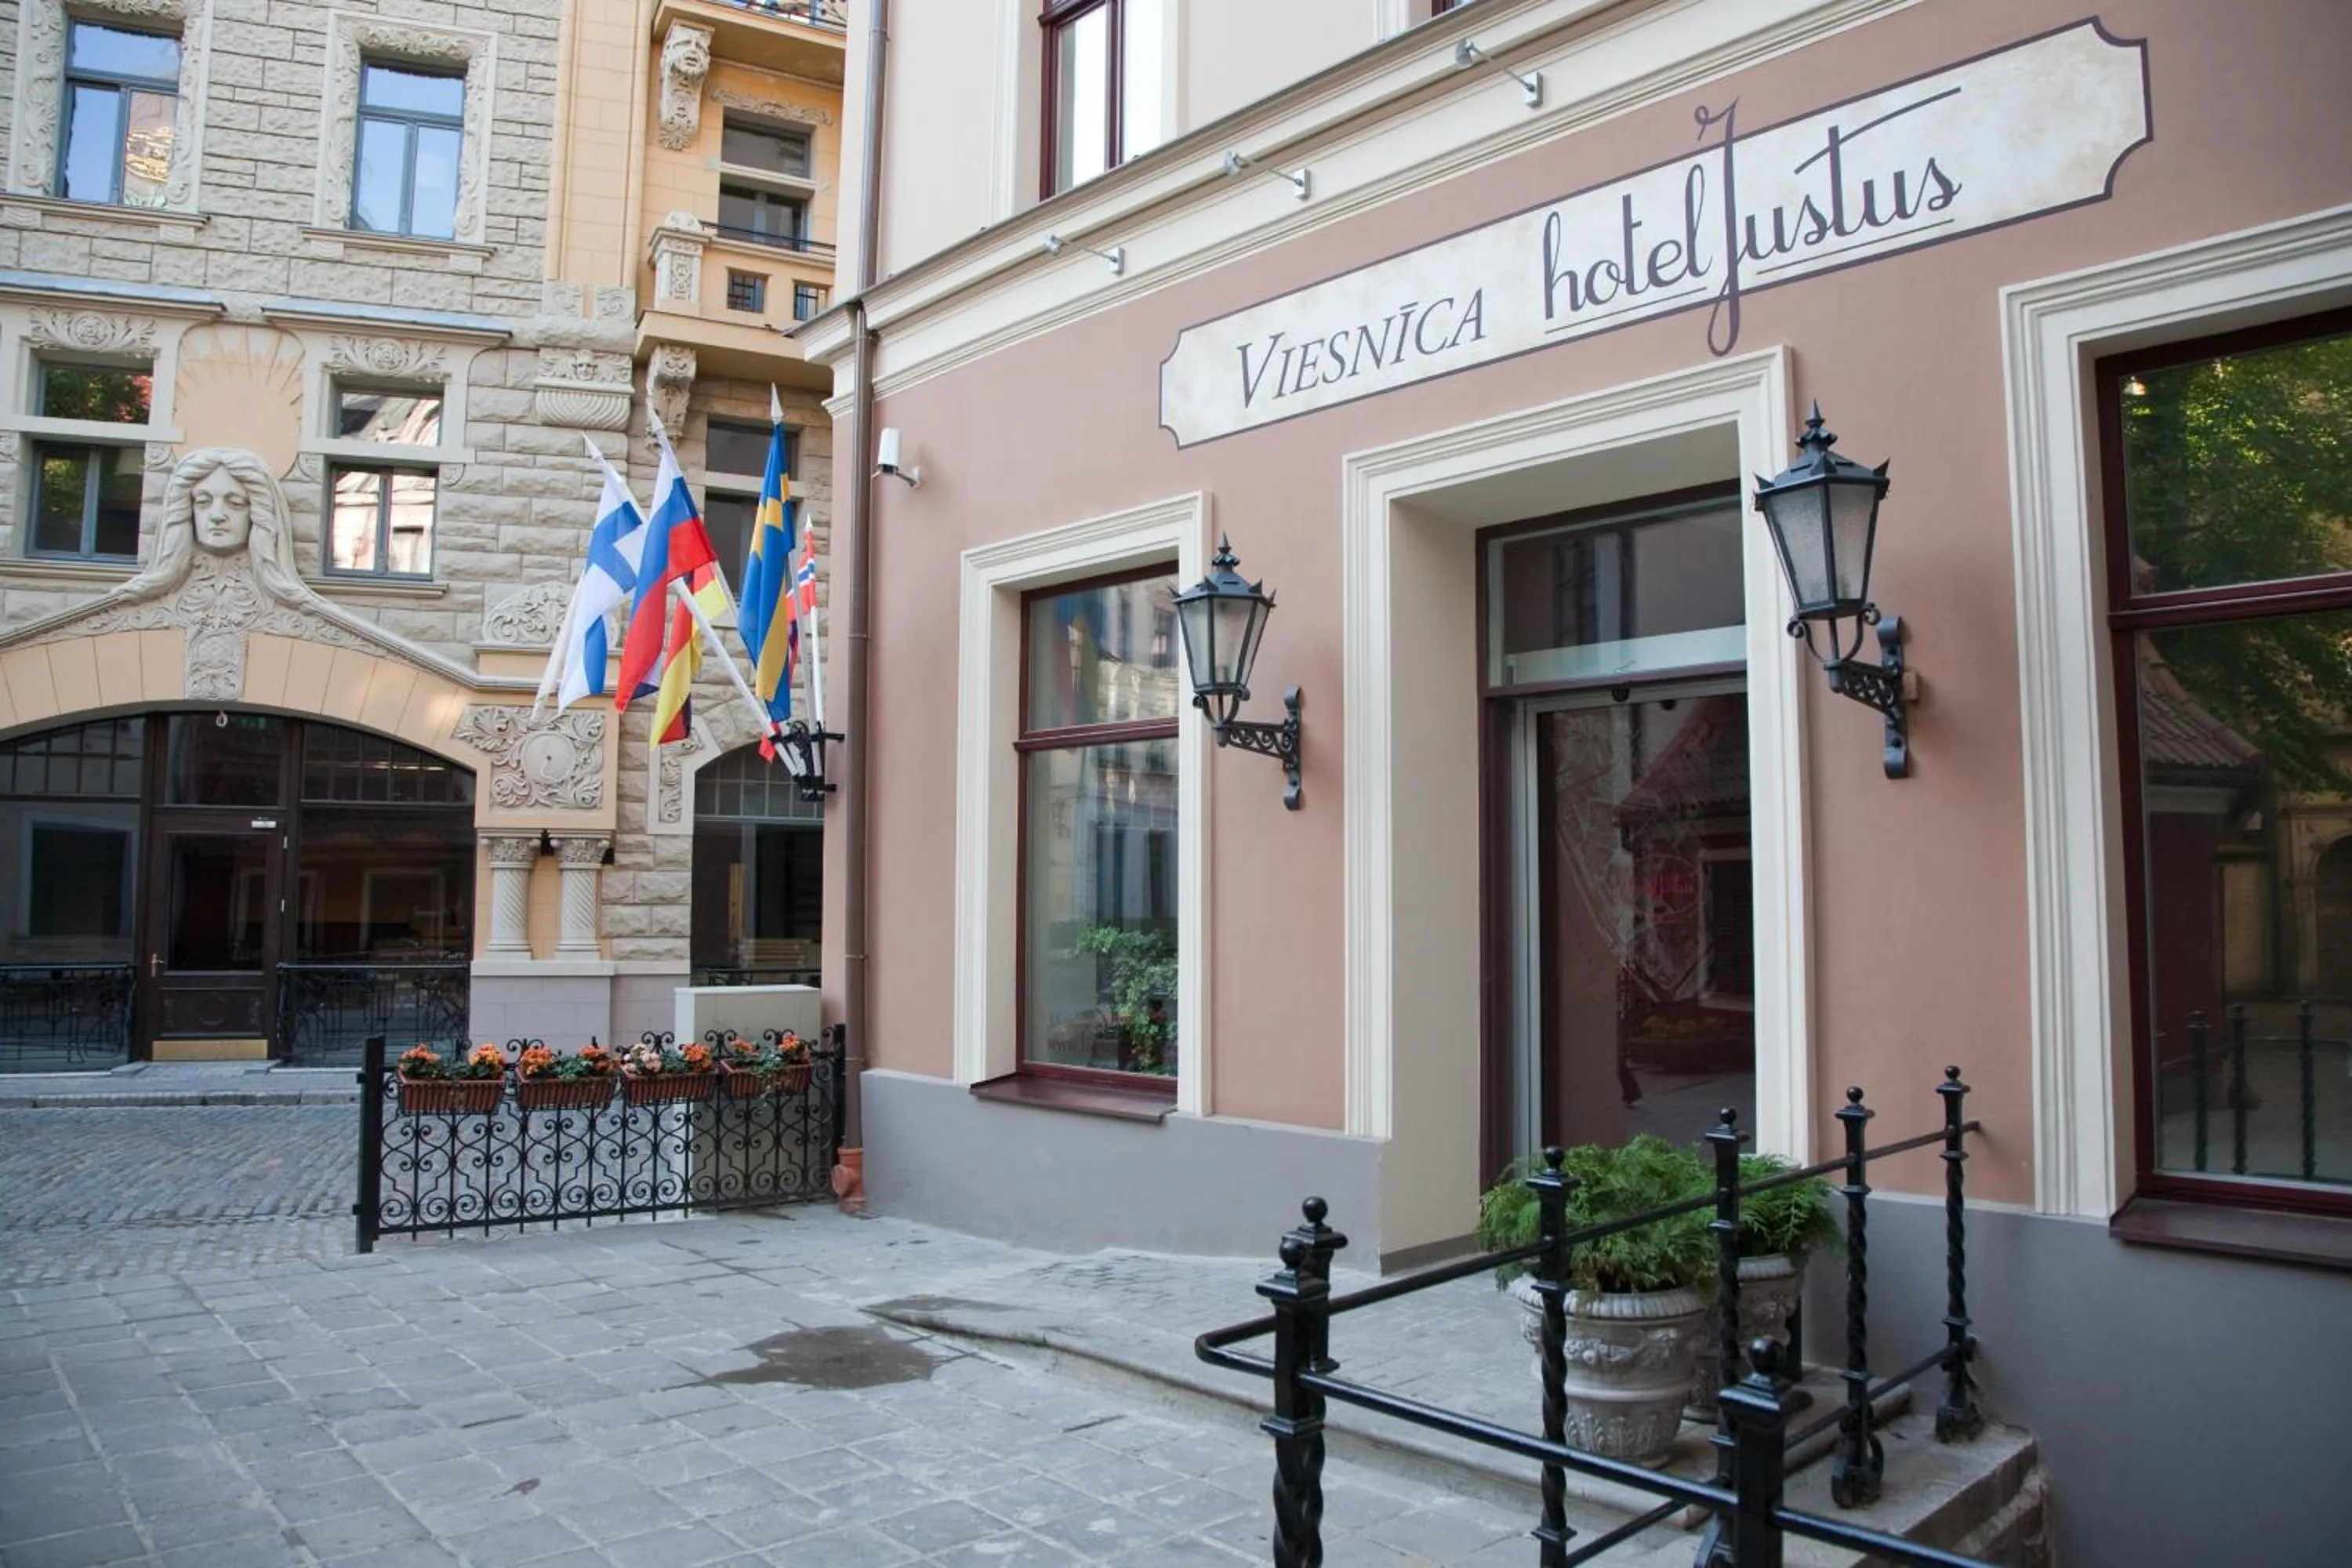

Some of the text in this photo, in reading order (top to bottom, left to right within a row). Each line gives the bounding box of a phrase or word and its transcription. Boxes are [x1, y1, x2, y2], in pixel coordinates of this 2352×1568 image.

[1236, 86, 1962, 408] VIESNĪCA hotel Justus
